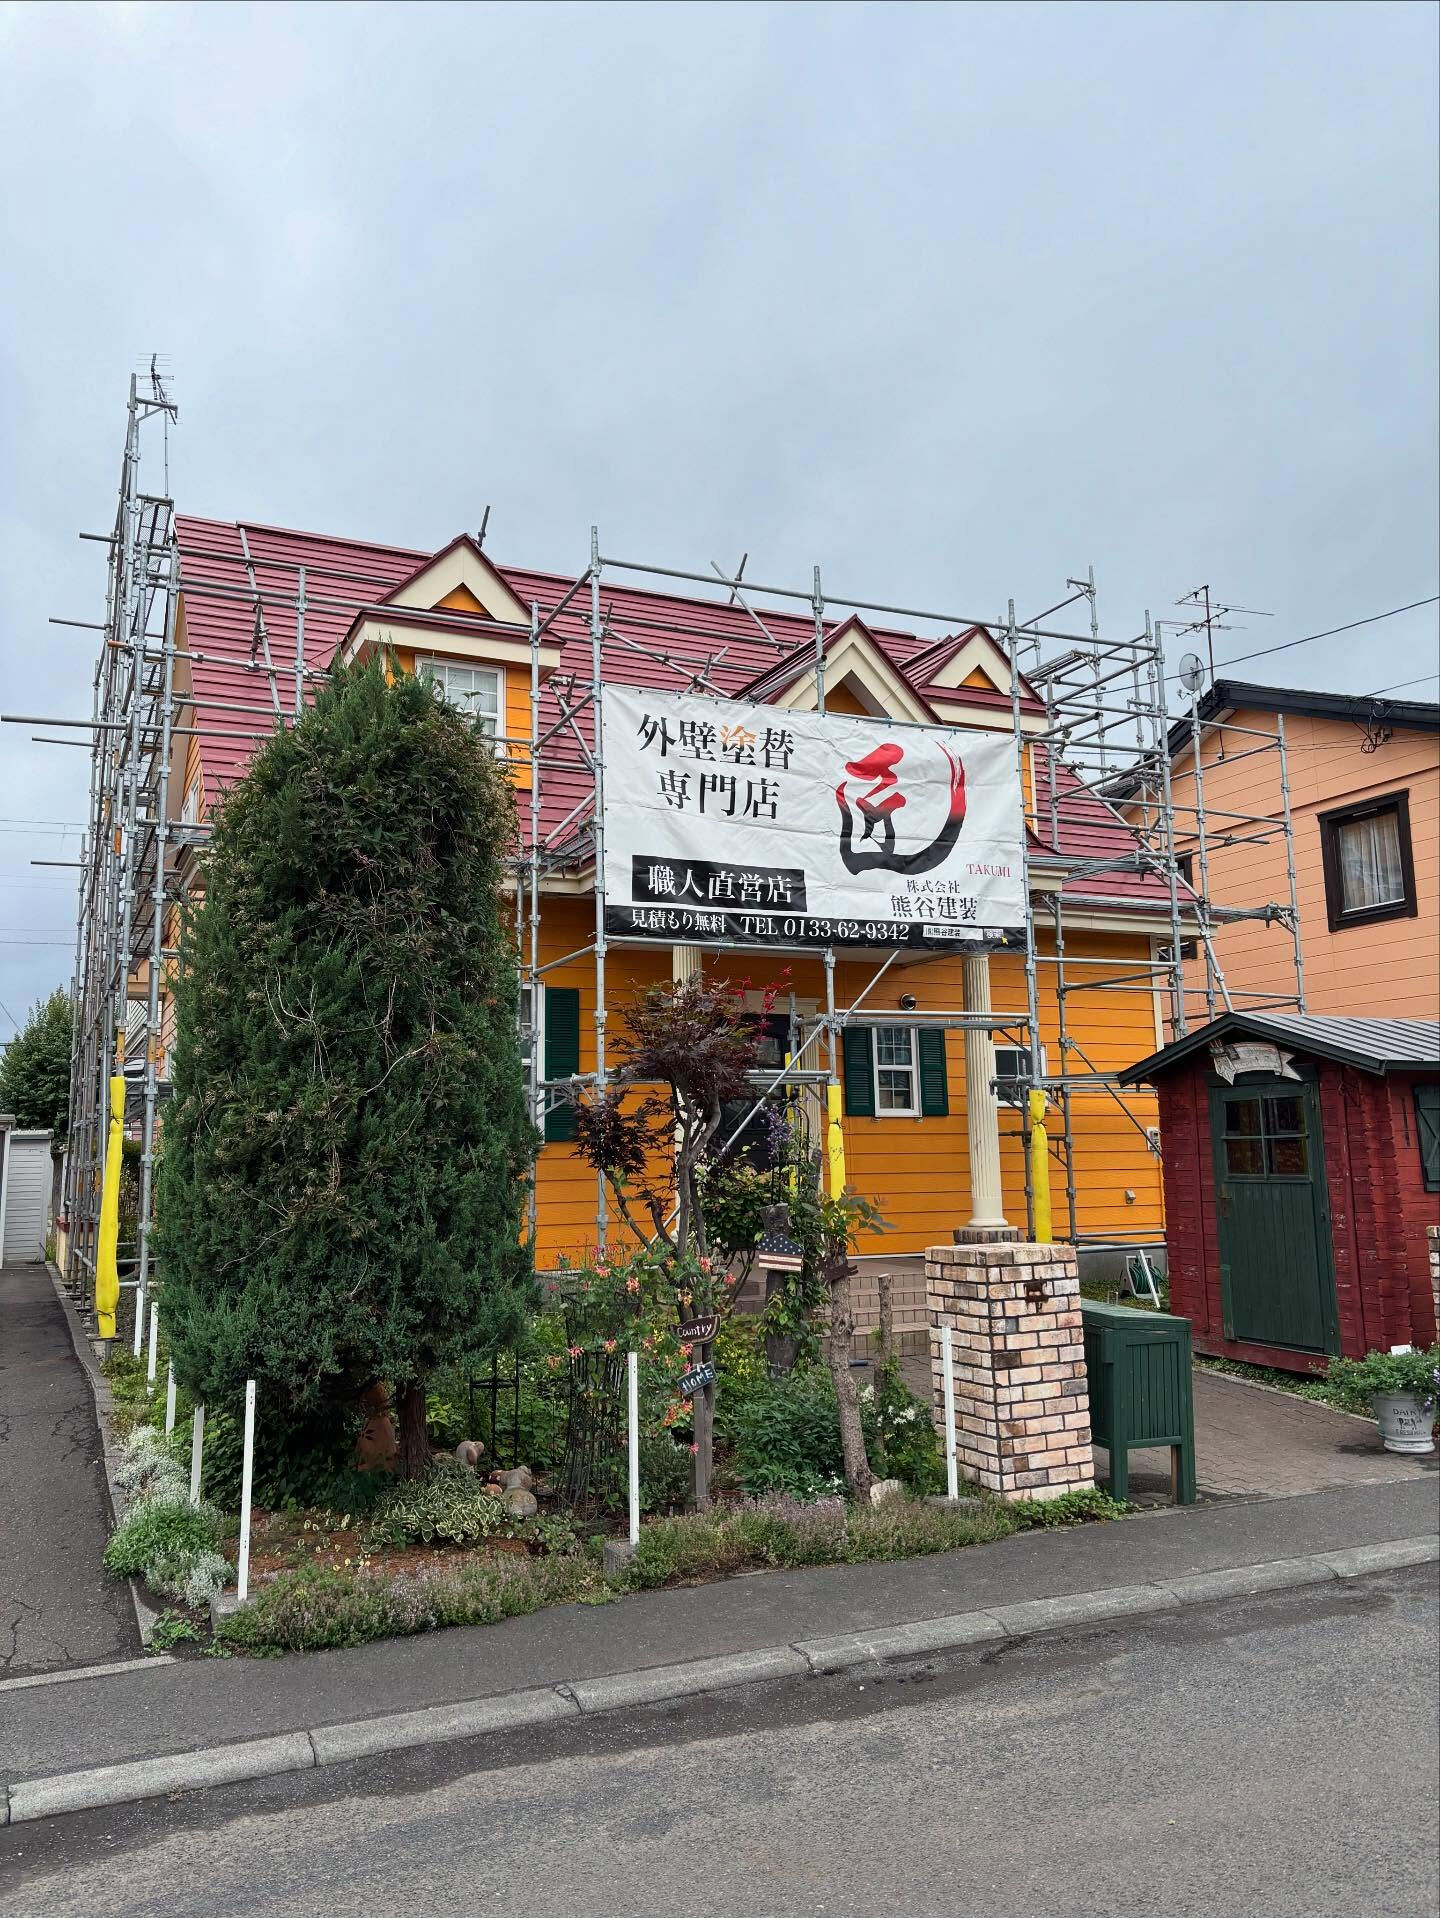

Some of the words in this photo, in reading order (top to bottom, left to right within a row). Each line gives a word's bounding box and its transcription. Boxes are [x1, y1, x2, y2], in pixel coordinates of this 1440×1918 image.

[636, 713, 795, 770] 外壁塗替
[656, 769, 781, 820] 専門店
[647, 865, 792, 904] 職人直営店
[966, 863, 1011, 878] TAKUMI
[907, 879, 961, 894] 株式会社
[891, 895, 978, 921] 熊谷建装
[630, 909, 727, 934] 見積もり無料
[740, 916, 778, 936] TEL
[783, 918, 910, 941] 0133-62-9342
[677, 1323, 712, 1338] Country
